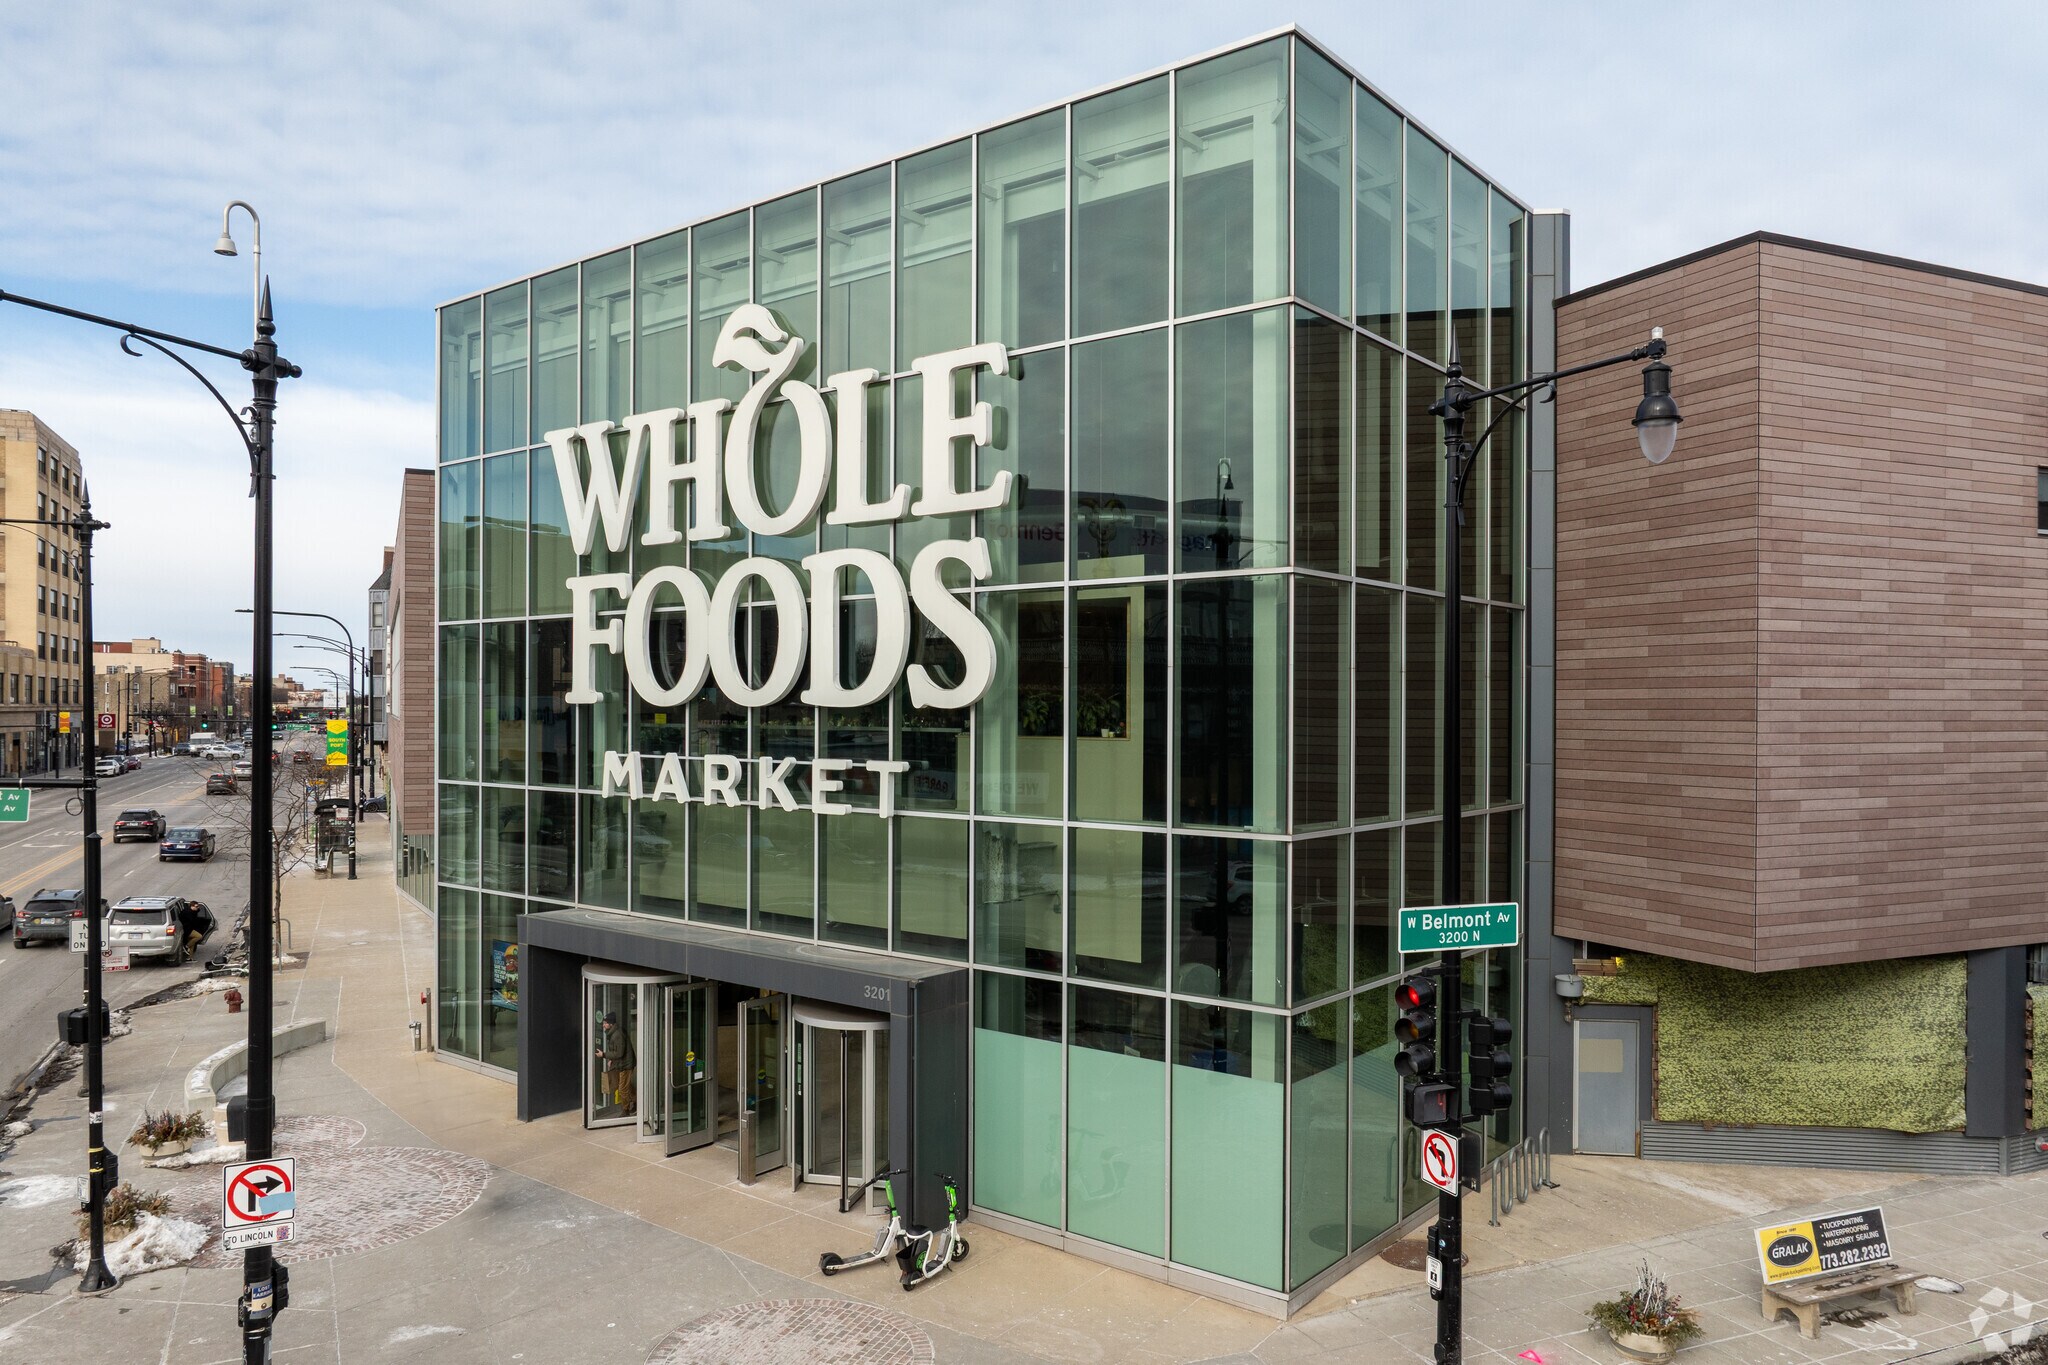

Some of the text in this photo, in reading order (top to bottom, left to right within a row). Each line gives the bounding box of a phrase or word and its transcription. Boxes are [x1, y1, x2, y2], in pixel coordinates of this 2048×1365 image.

[544, 303, 1012, 556] WHOLE
[565, 537, 997, 708] FOODS
[602, 751, 911, 818] MARKET
[7, 793, 20, 801] Av
[1407, 911, 1510, 930] W Belmont Av
[1439, 930, 1480, 943] 3200 N
[73, 941, 86, 949] ON
[864, 985, 890, 1001] 3201
[1822, 1216, 1864, 1229] TUCKPOINTING
[240, 1231, 274, 1242] LINCOLN
[1824, 1224, 1869, 1238] WATERPROOFING
[1826, 1231, 1880, 1247] MASONRY SEALING
[1772, 1242, 1809, 1259] GRALAK
[1820, 1243, 1889, 1269] 773.282.2332
